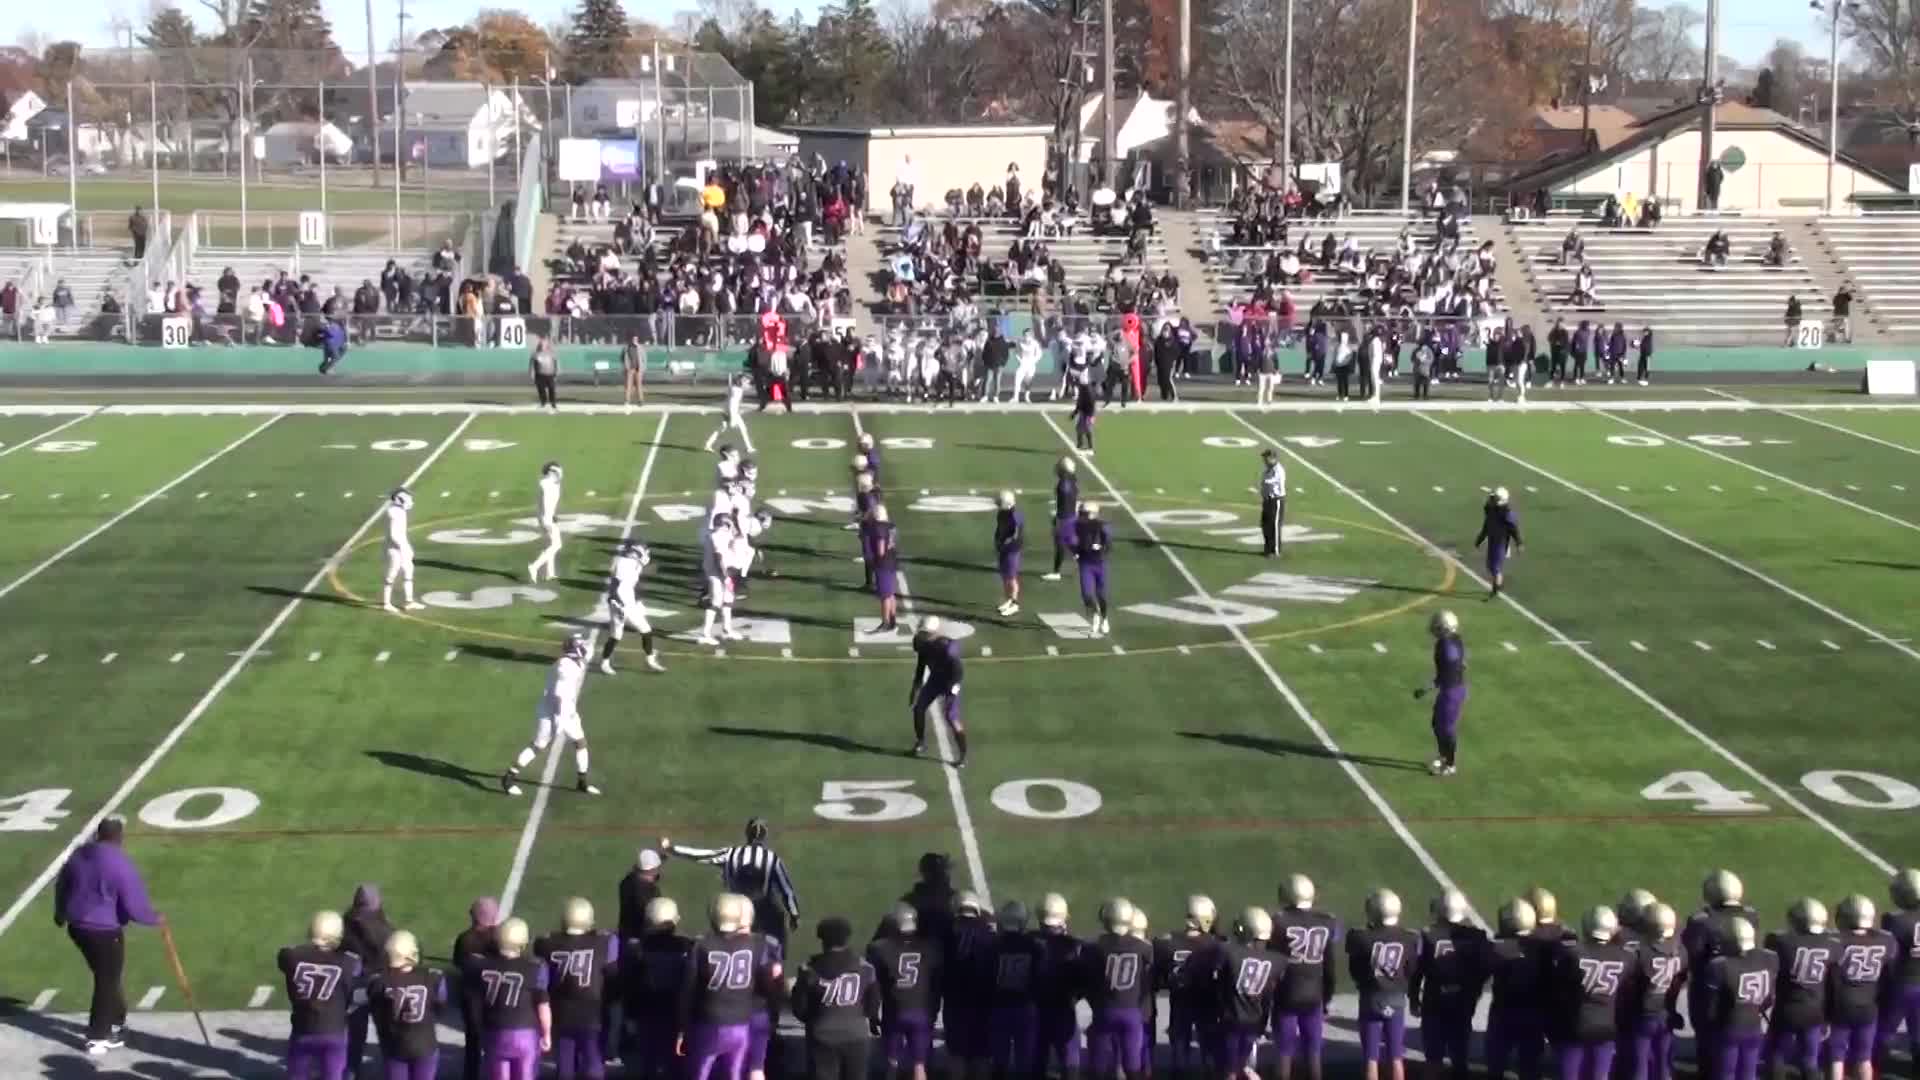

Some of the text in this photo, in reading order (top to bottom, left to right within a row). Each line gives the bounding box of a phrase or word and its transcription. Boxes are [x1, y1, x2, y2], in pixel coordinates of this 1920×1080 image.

[165, 325, 186, 345] 30
[503, 325, 523, 345] 40
[1801, 327, 1820, 346] 20
[0, 787, 261, 831] 40
[813, 778, 1102, 822] 50
[1639, 770, 1920, 812] 40
[1286, 926, 1329, 964] 20
[293, 962, 342, 1001] 57
[551, 949, 594, 987] 74
[708, 949, 753, 990] 78
[897, 952, 921, 988] 5
[1105, 953, 1138, 991] 10
[1579, 958, 1624, 995] 75
[1791, 947, 1829, 984] 16
[481, 970, 524, 1008] 77
[819, 972, 860, 1006] 70
